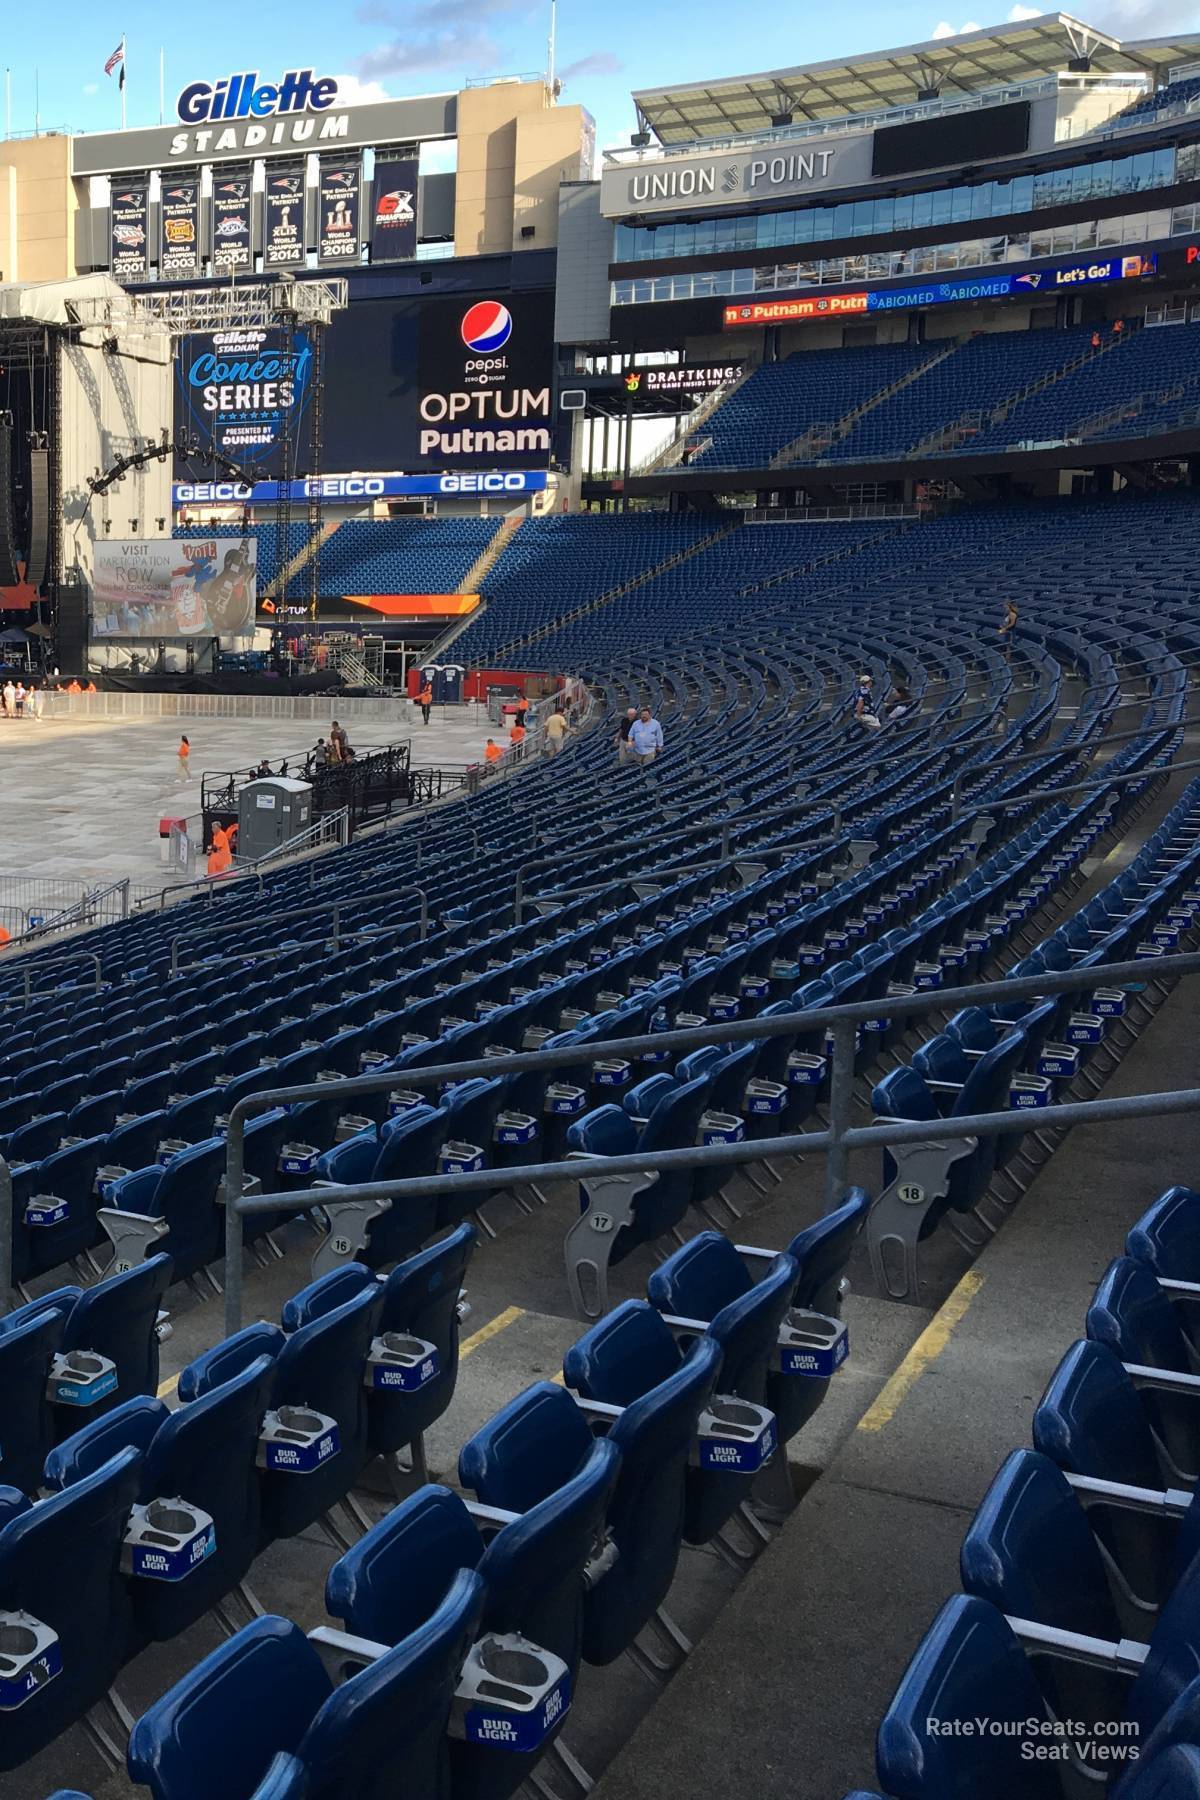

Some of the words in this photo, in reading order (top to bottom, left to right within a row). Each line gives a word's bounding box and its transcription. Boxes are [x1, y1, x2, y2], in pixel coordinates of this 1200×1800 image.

[177, 68, 338, 124] Gillette
[169, 115, 349, 155] STADIUM
[633, 167, 715, 200] UNION
[750, 150, 834, 186] POINT
[272, 198, 299, 206] PATRIOTS
[376, 213, 414, 222] CHAMPIONS
[272, 227, 297, 236] XLIX
[267, 243, 302, 251] CHAMPIONS
[321, 238, 356, 246] CHAMPIONS
[214, 248, 249, 256] CHAMPIONS
[269, 250, 300, 261] 2014
[323, 244, 354, 256] 2016
[113, 256, 145, 264] CHAMPIONS
[164, 258, 195, 269] 2003
[215, 253, 248, 265] 2004
[115, 263, 144, 273] 2001
[1056, 268, 1085, 284] Let's
[1087, 263, 1110, 279] Go!
[877, 292, 934, 308] ABIOMED
[950, 282, 1009, 299] ABIOMED
[754, 301, 813, 318] Putnam
[213, 331, 267, 344] Gillette
[218, 344, 259, 354] STADIUM
[647, 367, 742, 383] DRAFTKINGS
[203, 381, 295, 411] SERIES
[420, 388, 550, 422] OPTUM
[226, 427, 261, 435] PRESENTED
[263, 426, 272, 434] BY
[222, 434, 274, 445] DUNKIN'
[420, 428, 550, 454] Putnam
[177, 484, 252, 501] GEICO
[304, 478, 385, 496] GEICO
[440, 473, 526, 492] GEICO
[122, 545, 149, 556] VISIT
[185, 543, 217, 558] VOTE
[116, 567, 154, 581] ROW
[902, 1188, 920, 1200] 18
[594, 1216, 609, 1228] 17
[334, 1239, 347, 1252] 16
[119, 1263, 129, 1272] 15
[793, 1355, 816, 1363] BUD
[790, 1361, 819, 1370] LIGHT
[384, 1371, 402, 1379] BUD
[381, 1377, 405, 1386] LIGHT
[277, 1449, 297, 1458] BUD
[713, 1447, 737, 1456] BUD
[274, 1455, 301, 1465] LIGHT
[709, 1454, 742, 1463] LIGHT
[145, 1554, 166, 1564] BUD
[141, 1561, 170, 1572] LIGHT
[483, 1718, 512, 1731] BUD
[478, 1728, 518, 1742] LIGHT
